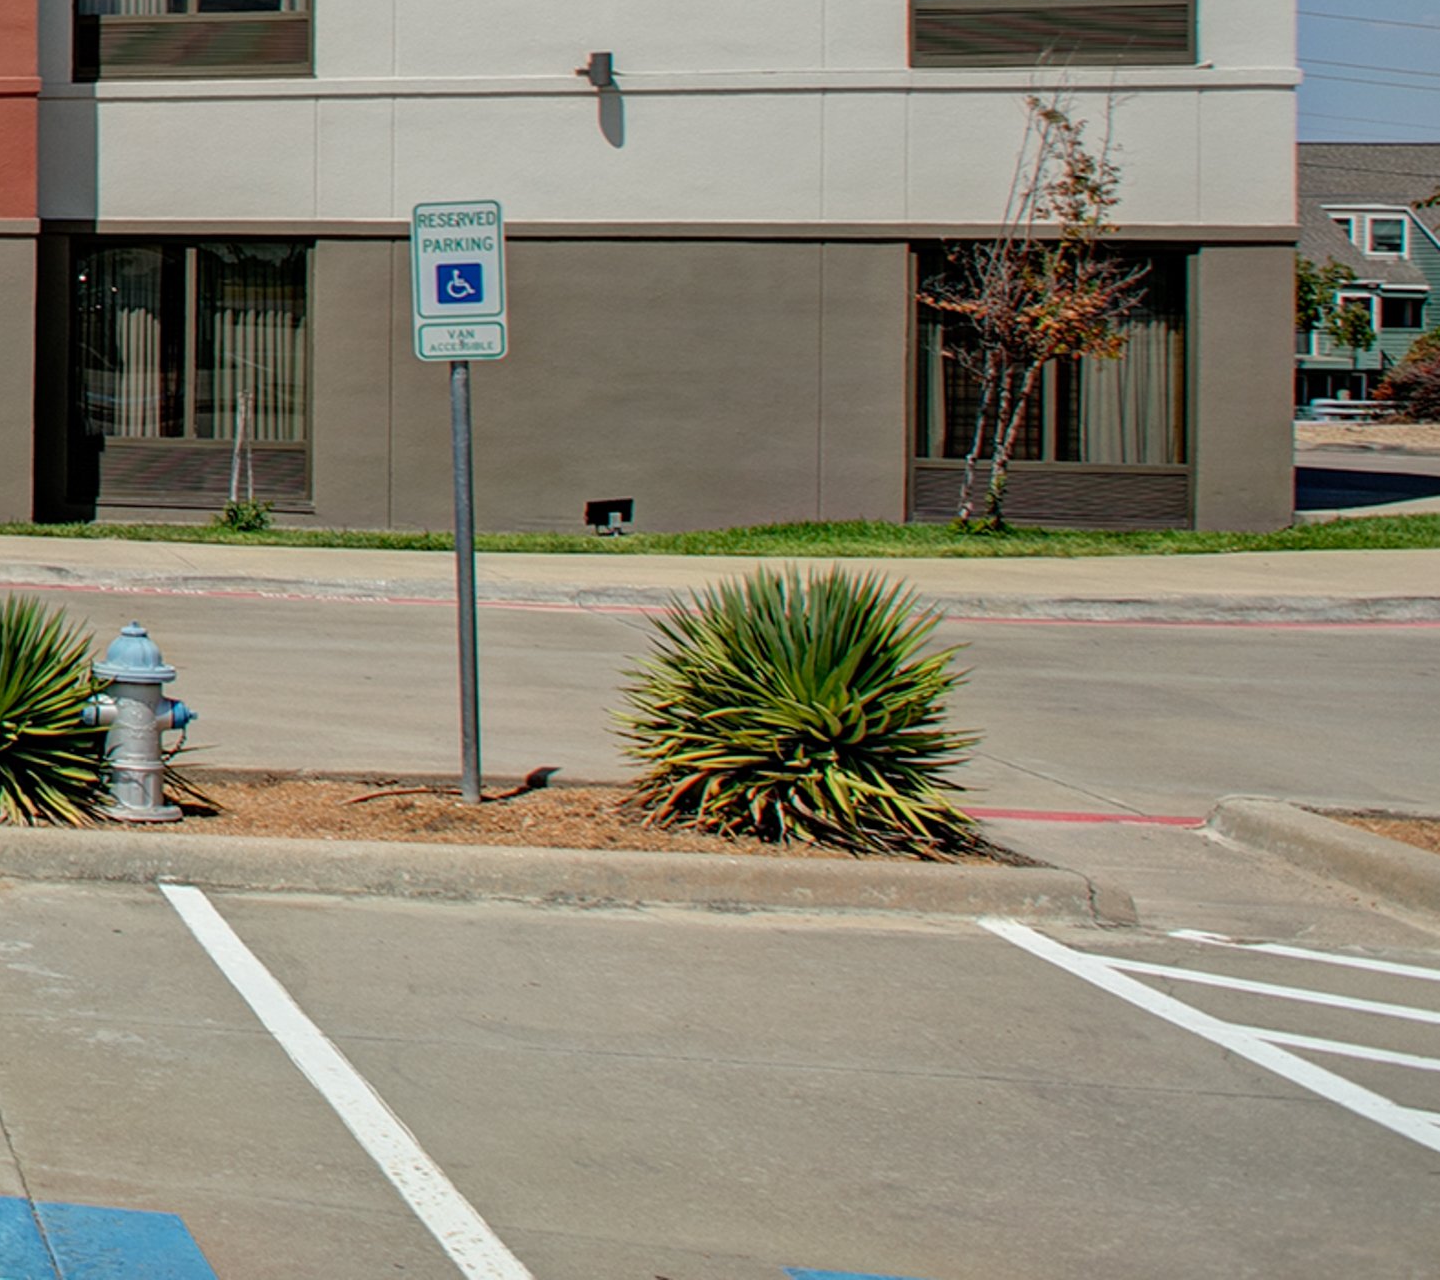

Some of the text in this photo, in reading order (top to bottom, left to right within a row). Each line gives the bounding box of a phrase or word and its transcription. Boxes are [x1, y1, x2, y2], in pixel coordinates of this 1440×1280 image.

[417, 211, 497, 228] RESERVED
[423, 237, 494, 253] PARKING
[447, 328, 476, 340] VAN
[429, 341, 494, 353] ACCESSIBLE
